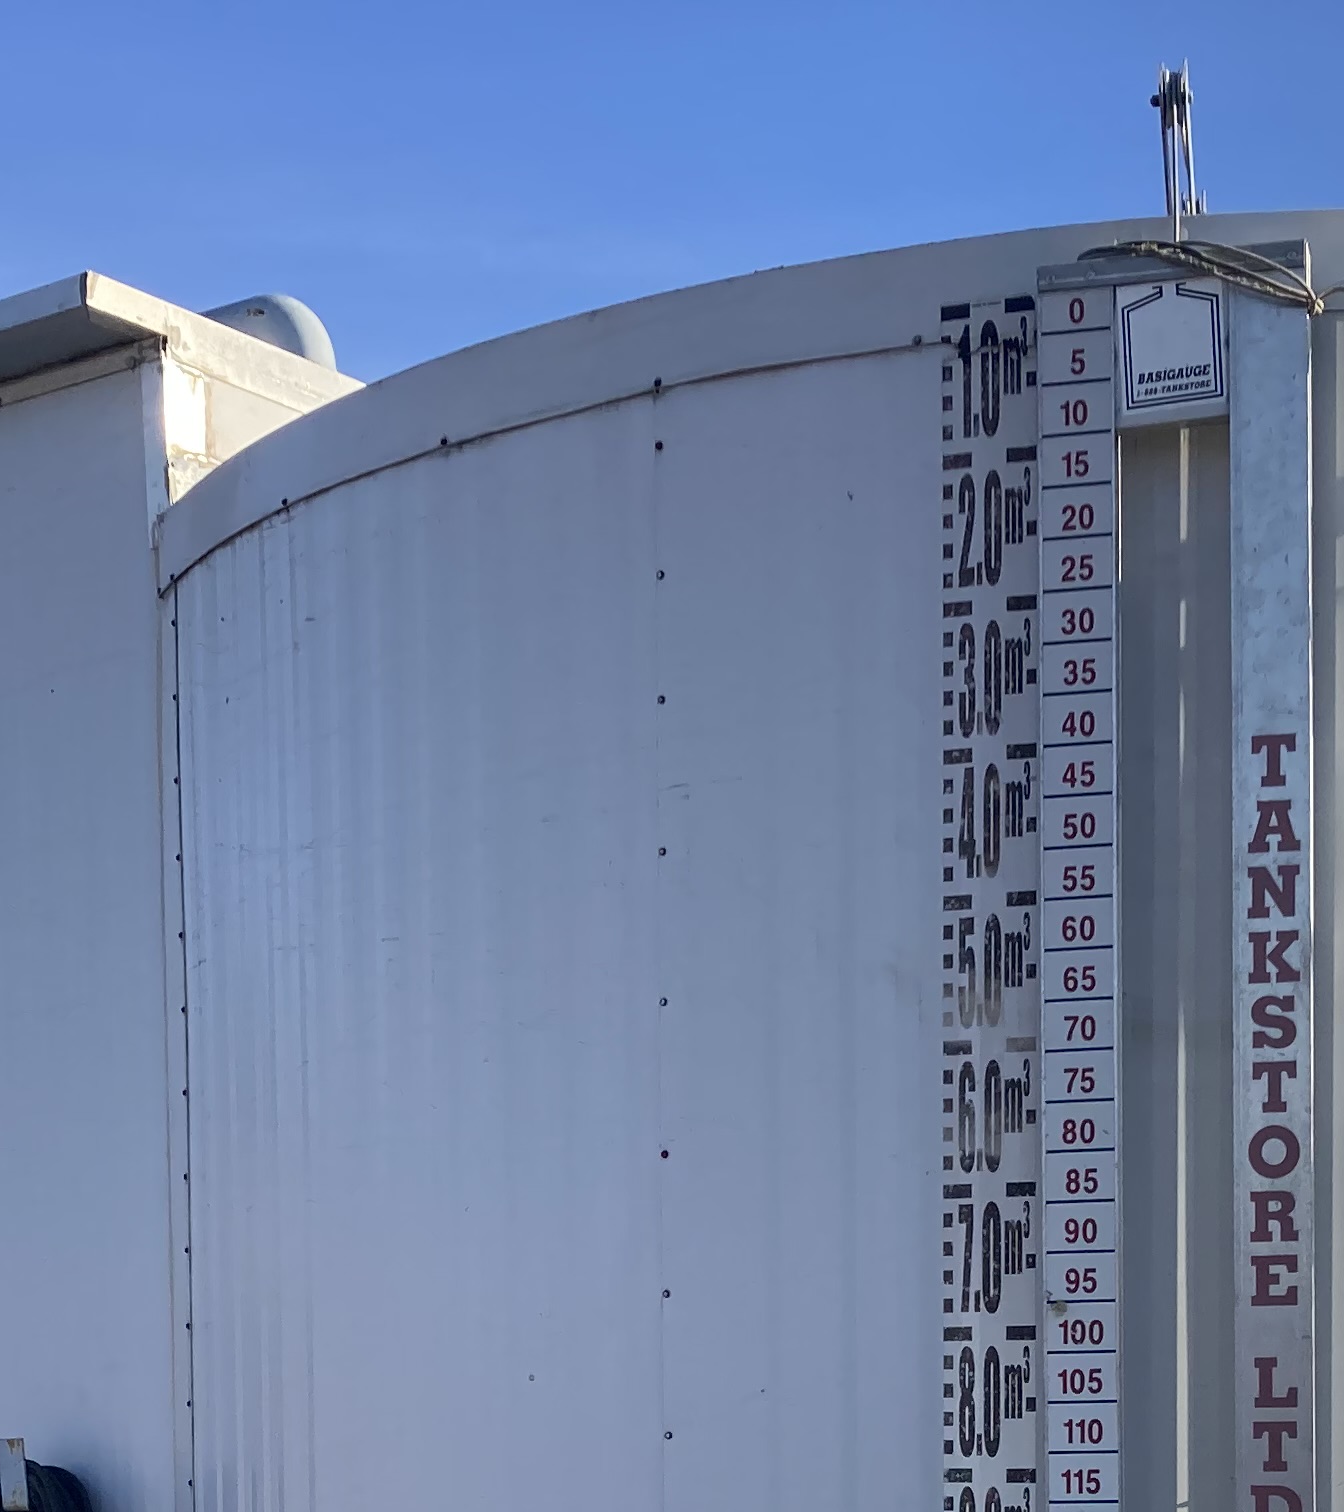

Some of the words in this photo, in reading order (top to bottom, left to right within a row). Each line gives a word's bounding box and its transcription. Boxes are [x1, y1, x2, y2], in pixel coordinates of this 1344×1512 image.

[1069, 298, 1085, 323] 0
[1071, 348, 1086, 375] 5
[1137, 363, 1211, 385] BASIGAUGE
[1060, 399, 1088, 426] 10
[1061, 451, 1090, 478] 15
[1062, 504, 1095, 532] 20
[1061, 554, 1094, 582] 25
[1063, 608, 1095, 636] 30
[1065, 659, 1097, 686] 35
[1062, 712, 1096, 738] 40
[1062, 761, 1097, 789] 45
[1064, 812, 1097, 841] 50
[1063, 865, 1096, 894] 55
[1061, 916, 1097, 943] 60
[1063, 965, 1097, 994] 65
[1063, 1015, 1097, 1042] 70
[1247, 733, 1301, 1307] TANKSTORE
[1064, 1068, 1096, 1093] 75
[1061, 1119, 1097, 1146] 80
[1065, 1168, 1100, 1195] 85
[1064, 1218, 1097, 1245] 90
[1064, 1268, 1099, 1295] 95
[1057, 1319, 1105, 1346] 100
[1058, 1368, 1104, 1396] 105
[1062, 1419, 1104, 1445] 110
[1061, 1468, 1102, 1495] 115
